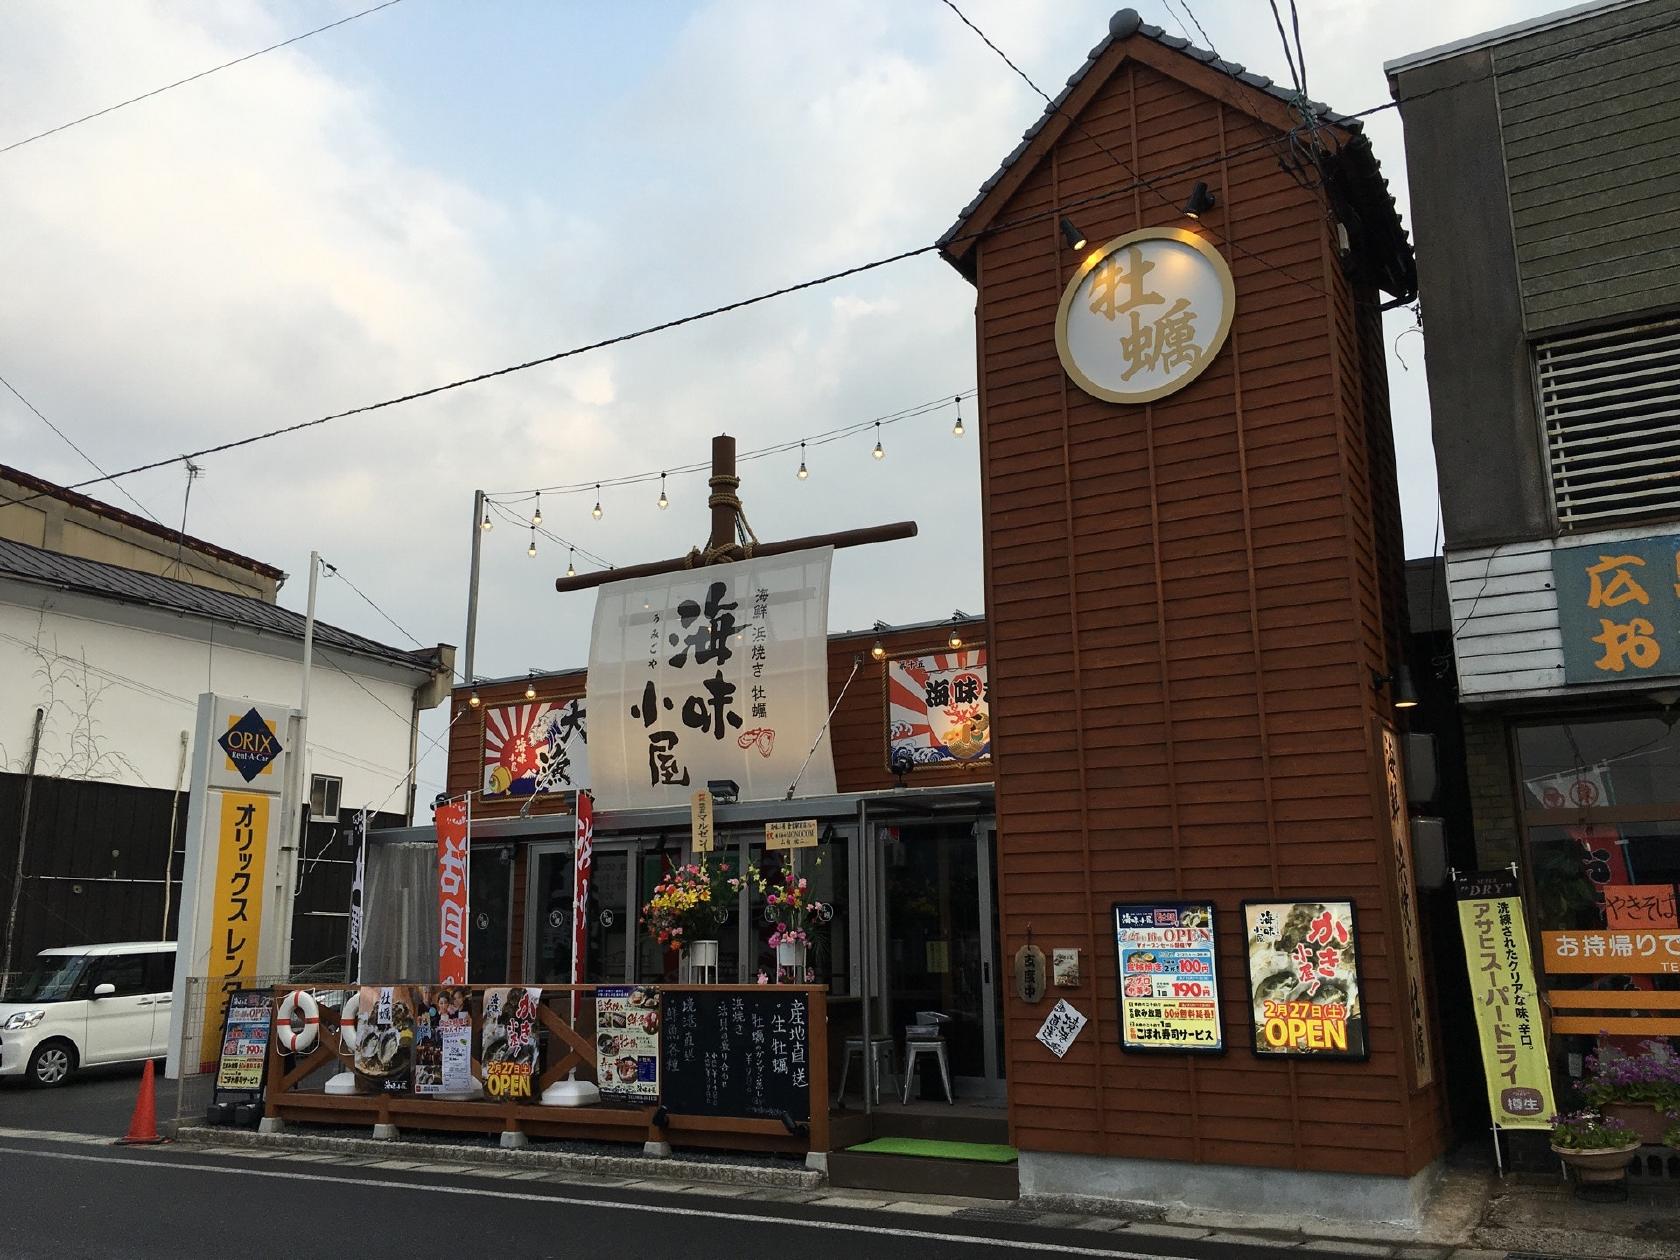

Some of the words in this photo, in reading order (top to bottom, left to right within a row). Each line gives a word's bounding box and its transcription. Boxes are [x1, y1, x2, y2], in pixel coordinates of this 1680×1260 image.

[1088, 246, 1203, 382] 牡蠣
[752, 588, 769, 619] 海鮮
[1585, 550, 1680, 609] 広
[668, 581, 753, 741] 海味
[751, 626, 767, 678] 浜焼き
[751, 684, 767, 719] 牡蠣
[227, 730, 273, 753] ORIX
[630, 680, 691, 788] 小屋
[226, 803, 257, 923] オリックス
[1606, 893, 1677, 922] やきそば
[1307, 911, 1349, 978] かき
[515, 992, 537, 1045] かき
[1263, 1002, 1347, 1019] 2月27日(土)
[1472, 902, 1518, 1085] アサヒスーパードライ
[771, 1014, 789, 1075] 生牡蠣
[788, 999, 809, 1088] 産地直送
[1265, 1018, 1347, 1049] OPEN
[487, 1075, 532, 1097] OPEN
